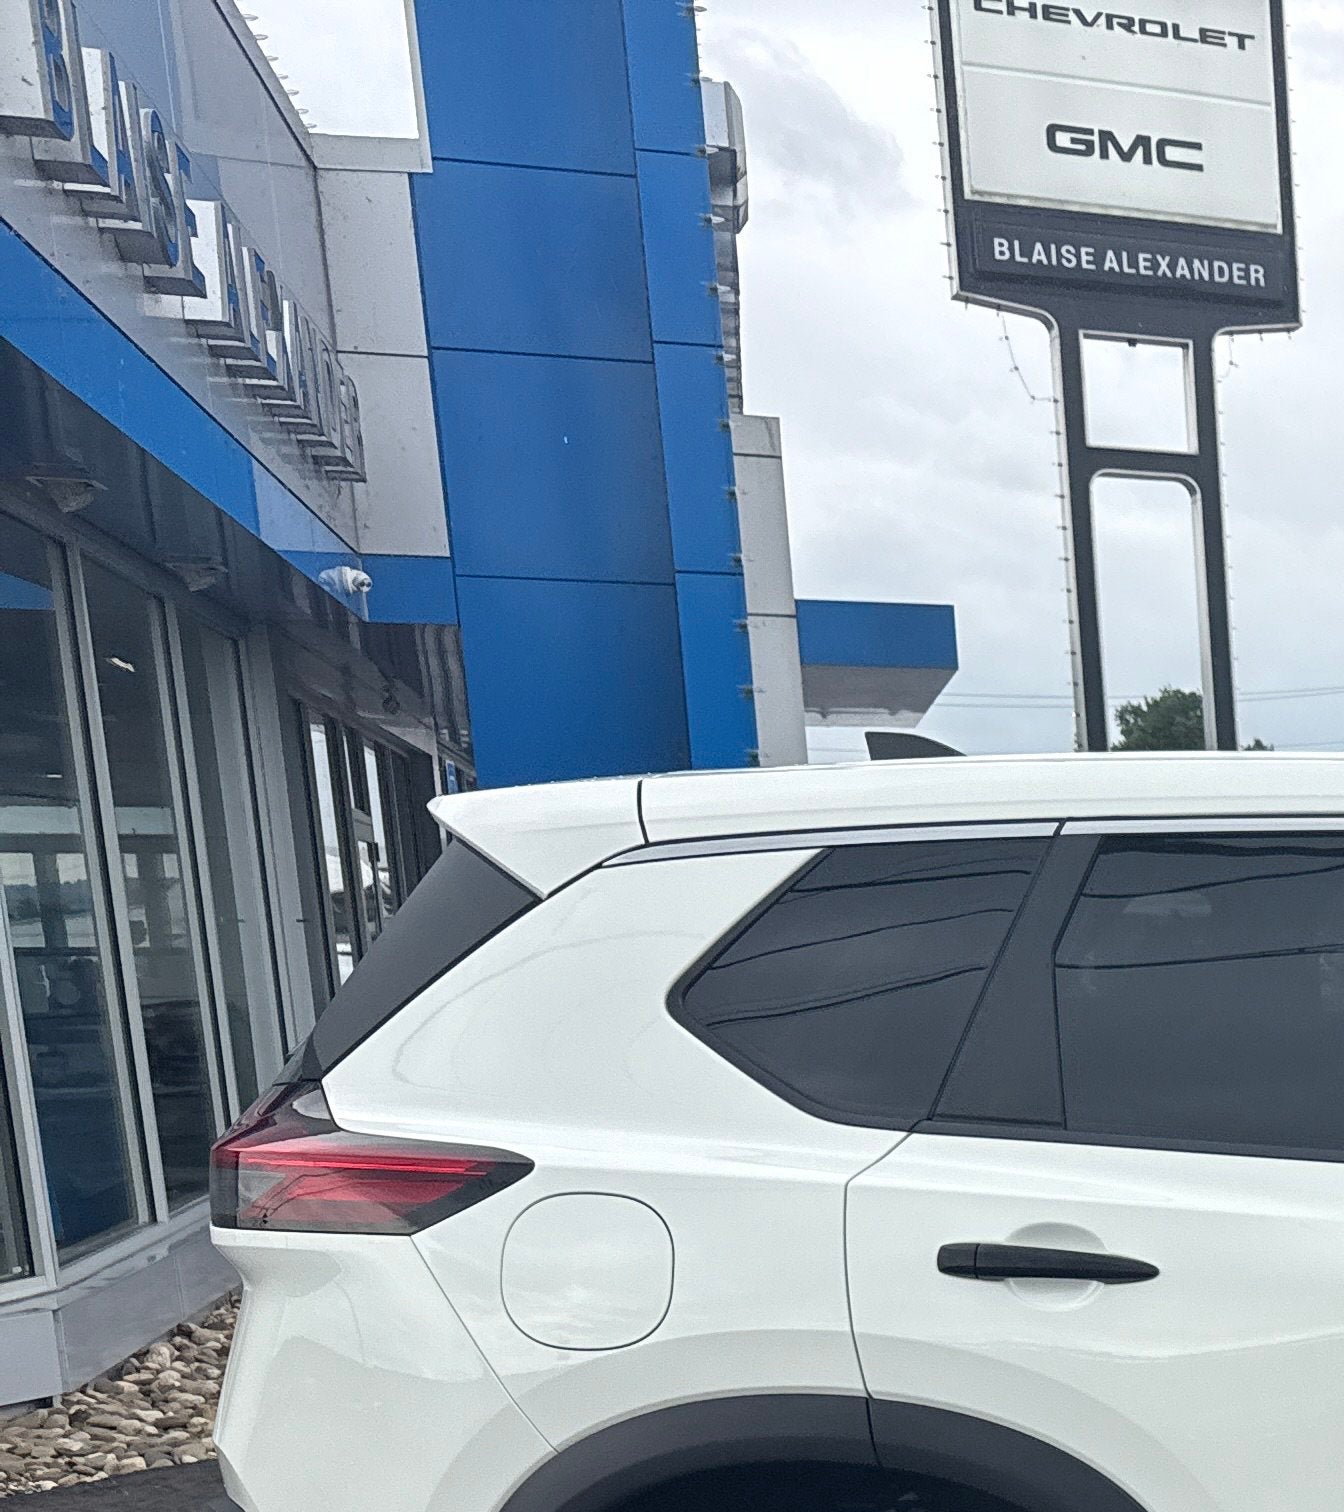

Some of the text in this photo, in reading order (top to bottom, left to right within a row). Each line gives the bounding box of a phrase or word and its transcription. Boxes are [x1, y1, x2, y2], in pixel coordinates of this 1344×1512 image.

[974, 0, 1256, 50] CHEVROLET
[1045, 123, 1204, 172] GMC
[993, 237, 1266, 288] BLAISE ALEXANDER
